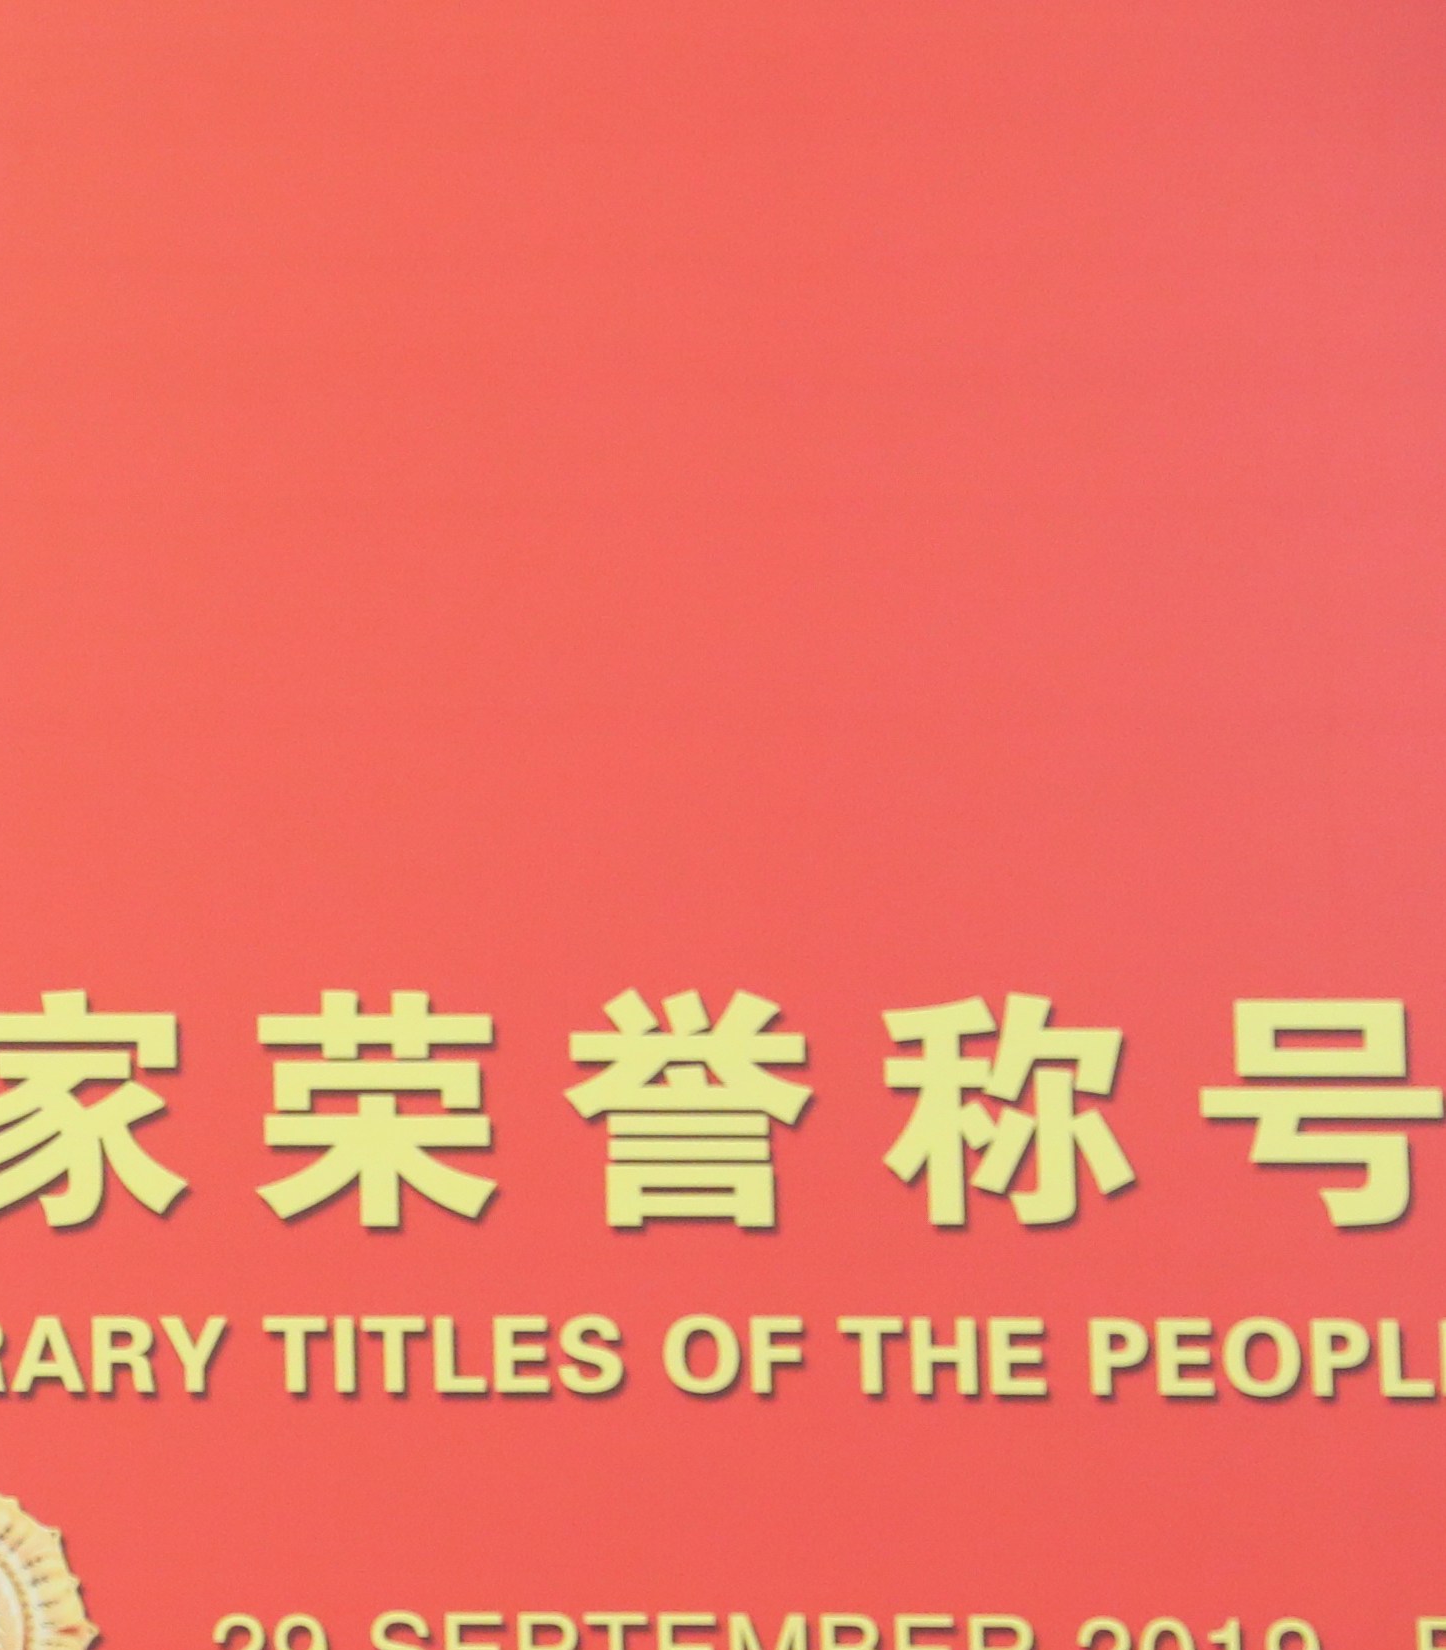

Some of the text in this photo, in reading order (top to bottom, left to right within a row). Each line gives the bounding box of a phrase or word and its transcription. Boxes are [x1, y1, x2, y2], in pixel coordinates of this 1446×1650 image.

[262, 1314, 622, 1394] TITLES
[663, 1314, 802, 1394] OF
[837, 1316, 1046, 1395] THE
[1089, 1317, 1446, 1397] PEOPL
